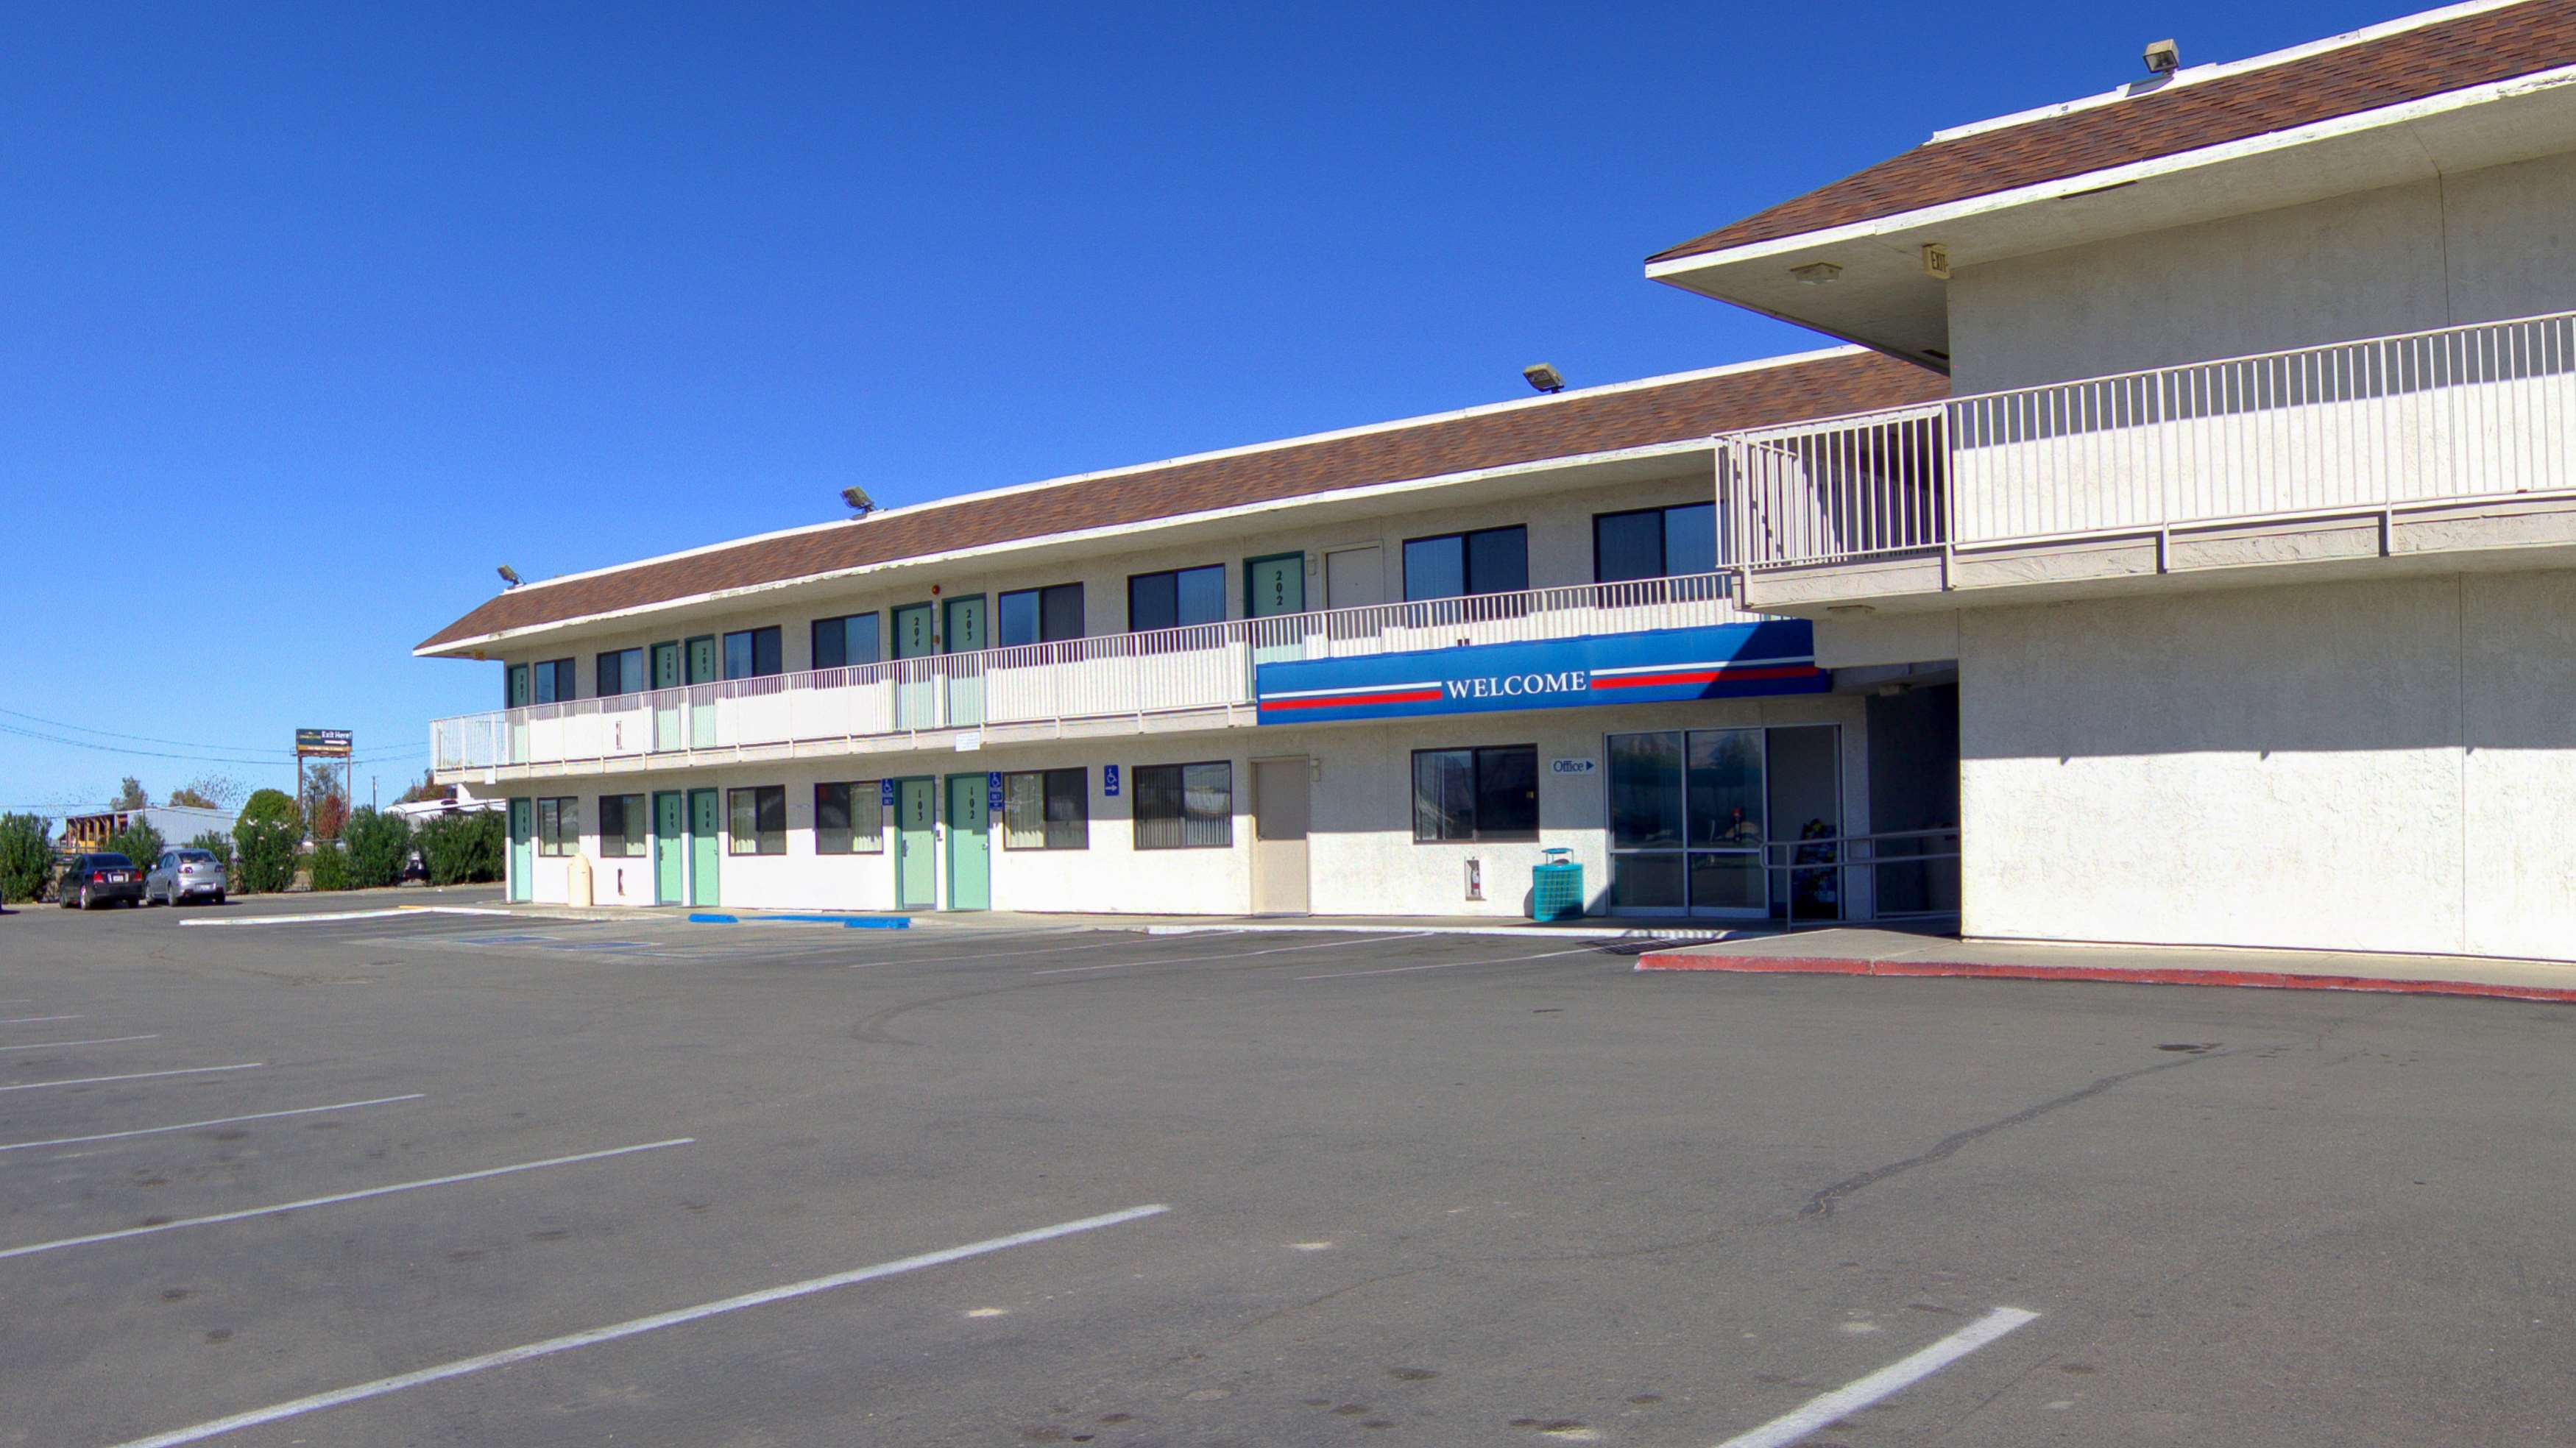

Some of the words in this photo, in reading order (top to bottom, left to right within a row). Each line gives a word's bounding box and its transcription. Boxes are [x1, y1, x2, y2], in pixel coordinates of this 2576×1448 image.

[1931, 250, 1947, 272] EXIT
[1446, 670, 1588, 700] WELCOME
[321, 731, 334, 739] Exit
[1554, 760, 1585, 773] Office
